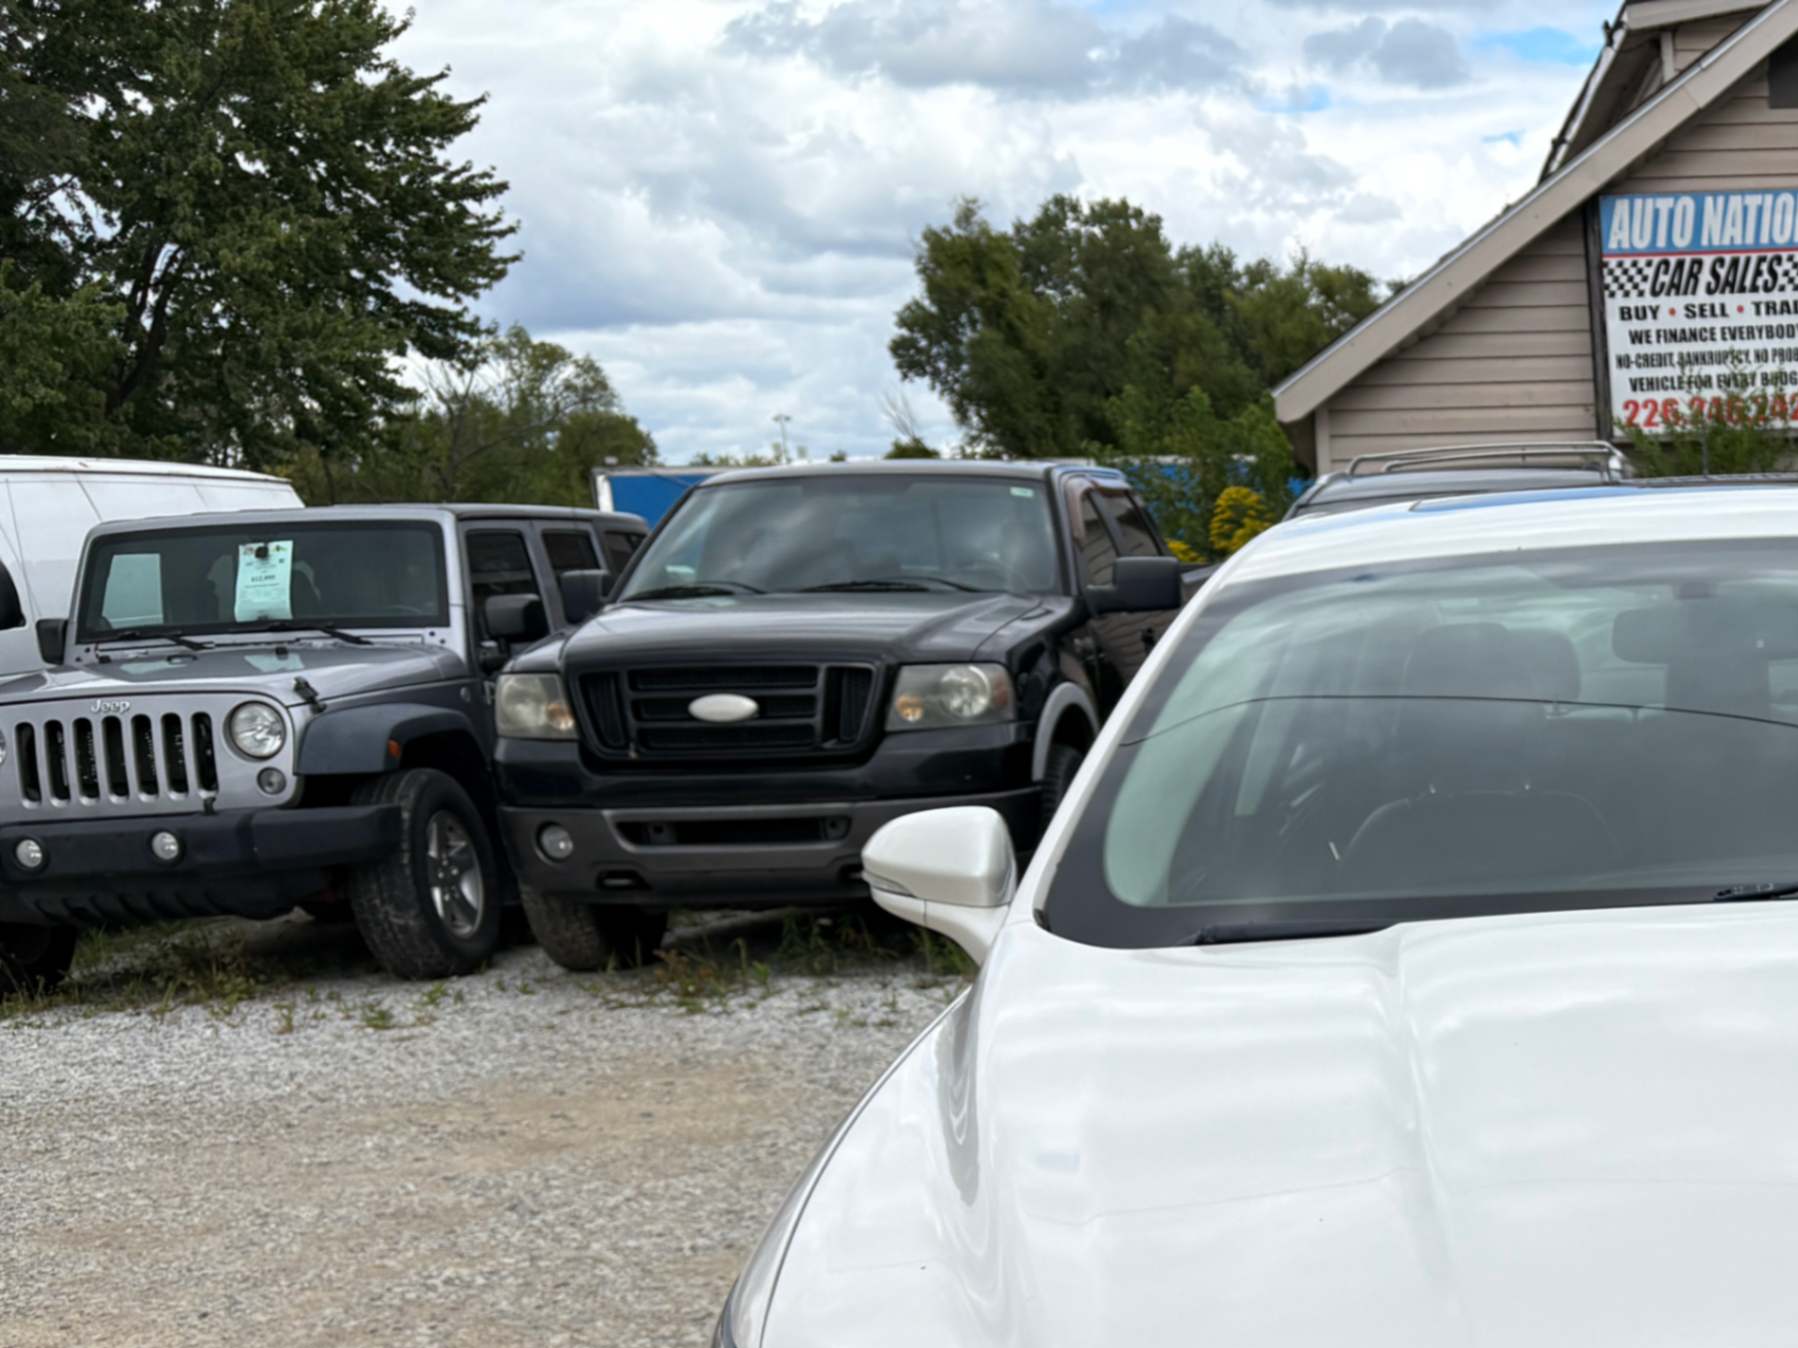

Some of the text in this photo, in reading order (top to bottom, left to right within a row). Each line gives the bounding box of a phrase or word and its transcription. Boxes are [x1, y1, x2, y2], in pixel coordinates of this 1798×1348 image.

[1608, 196, 1696, 249] AUTO
[1650, 254, 1783, 298] CAR SALES
[1618, 305, 1661, 321] BUY
[1684, 302, 1730, 319] SELL
[1629, 330, 1653, 345] WE
[1656, 326, 1716, 344] FINANCE
[1754, 347, 1769, 363] NO
[1629, 376, 1685, 392] VEHICLE
[1687, 374, 1714, 391] FOR
[1717, 372, 1757, 389] EVERY
[91, 700, 130, 714] Jeep
